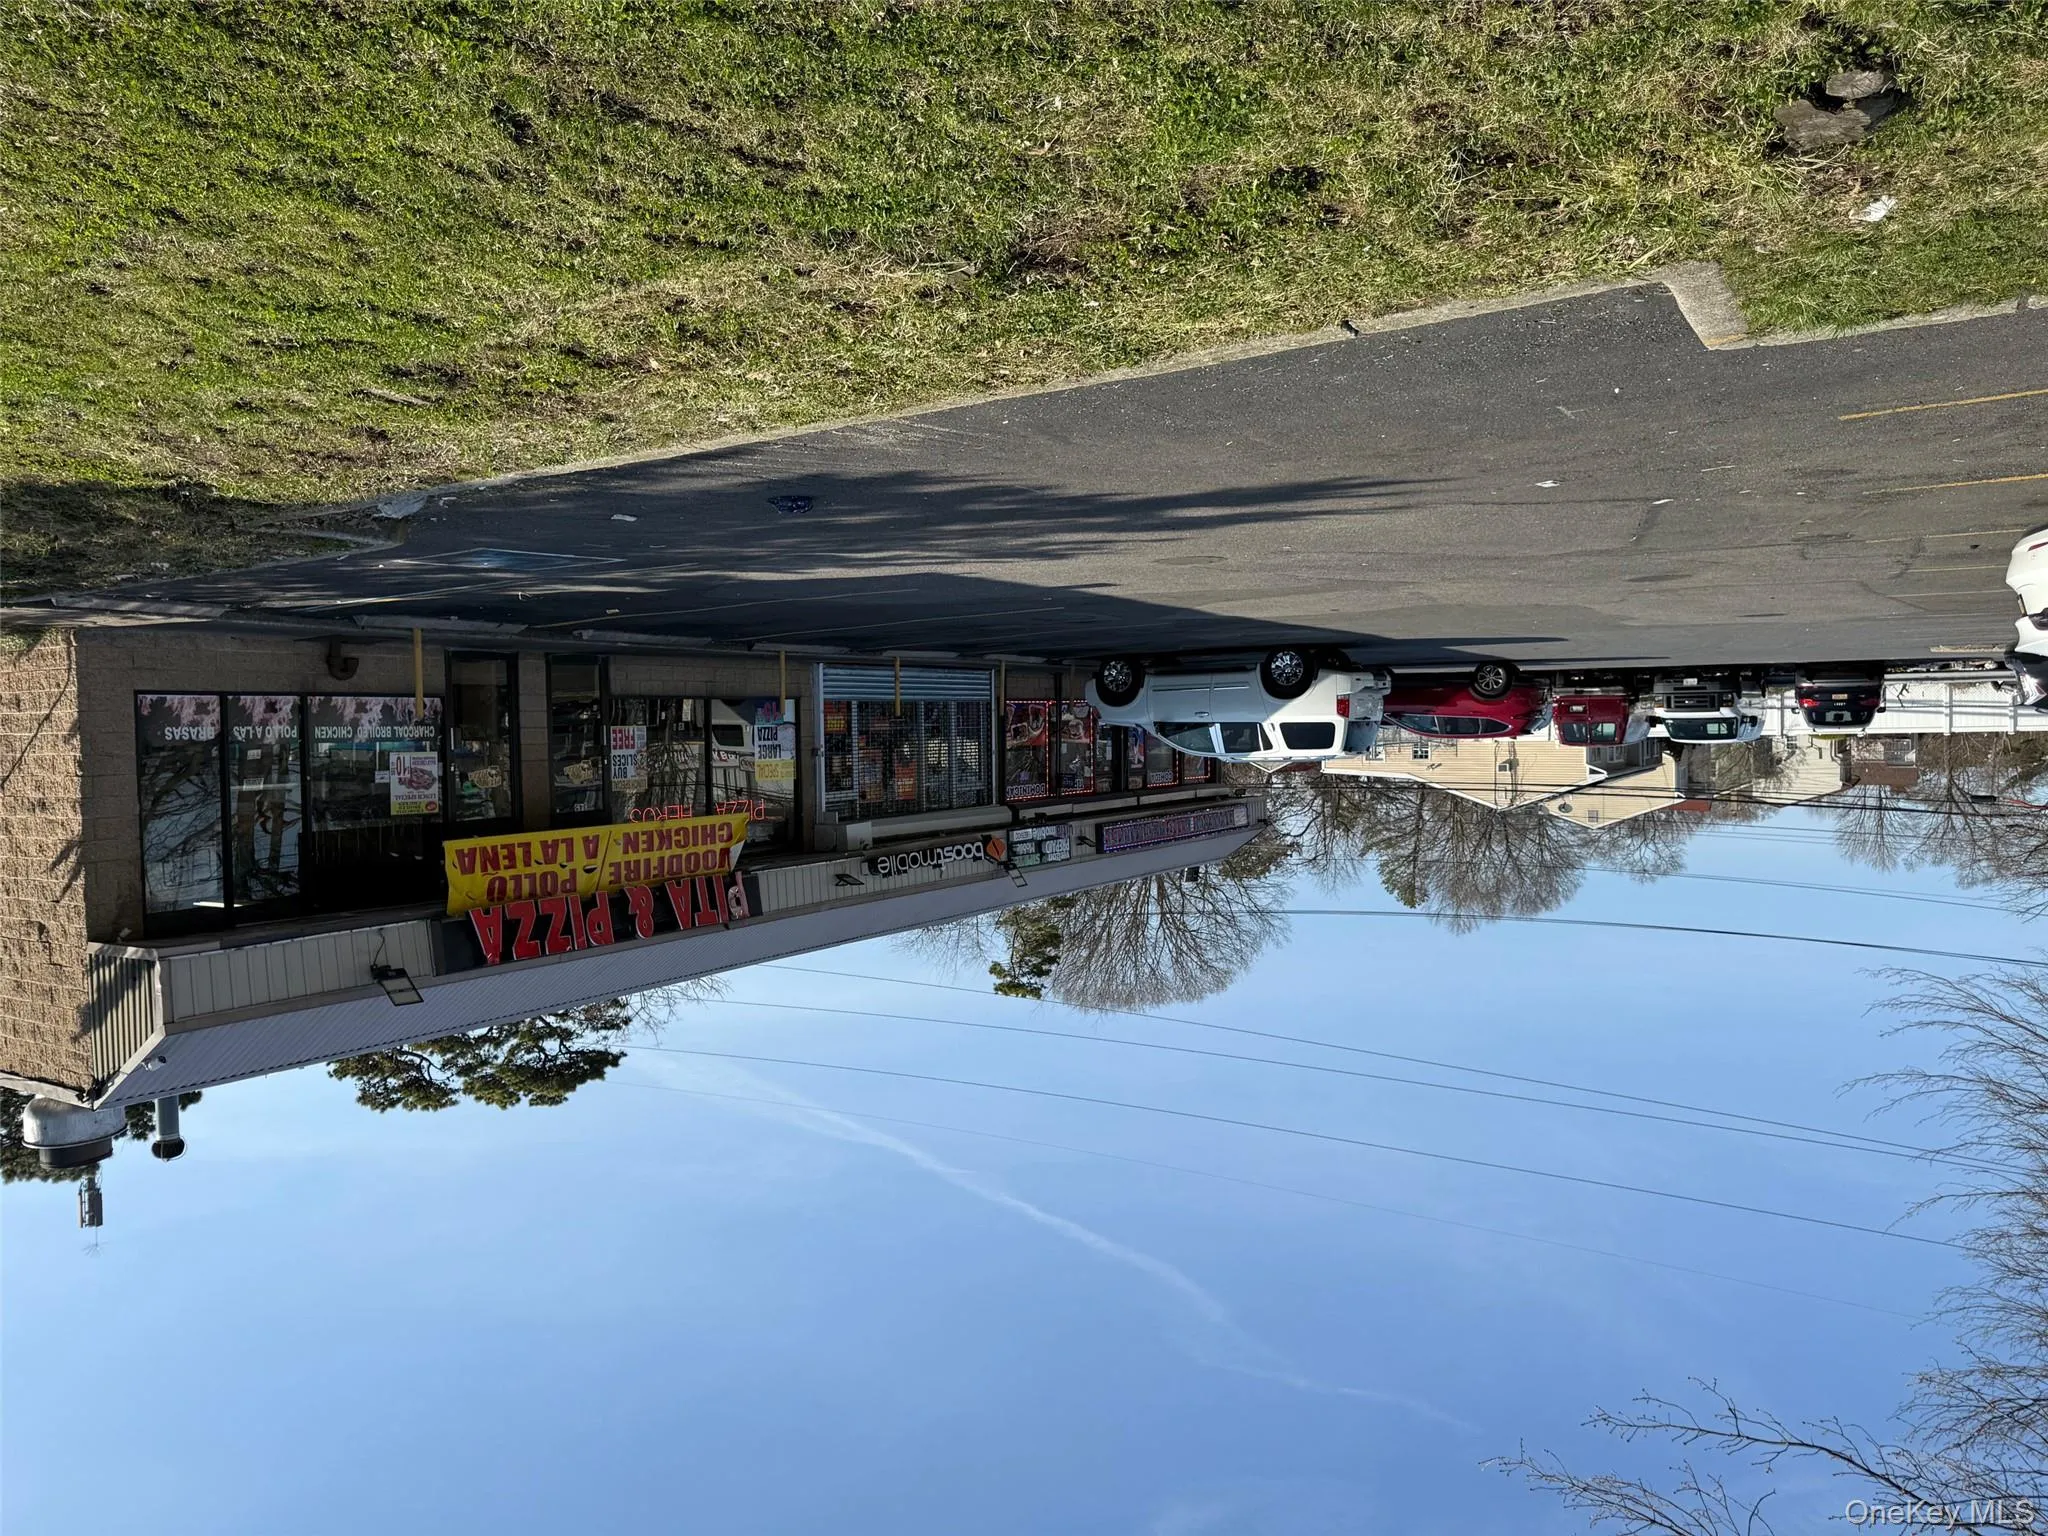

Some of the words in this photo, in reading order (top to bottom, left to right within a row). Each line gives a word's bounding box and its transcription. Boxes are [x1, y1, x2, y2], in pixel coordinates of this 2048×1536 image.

[164, 725, 215, 741] BRASAS
[254, 725, 263, 738] A
[265, 725, 297, 739] POLLO
[314, 726, 353, 739] CHICKEN
[357, 725, 392, 739] BROILED
[393, 725, 435, 739] CHARCOAL
[612, 728, 635, 750] FREE
[757, 726, 778, 741] PIZZA
[612, 754, 638, 766] SLICES
[757, 744, 782, 760] LARGE
[612, 767, 628, 779] BUY
[715, 799, 765, 820] PIZZA
[621, 822, 733, 855] CHICKEN
[1045, 839, 1069, 854] PREPAID
[539, 837, 574, 865] LA
[580, 834, 601, 860] A
[455, 842, 532, 877] LEÑA
[486, 868, 577, 903] POLLO
[665, 870, 749, 930] PITA
[623, 886, 655, 939] &
[468, 889, 615, 964] PIZZA
